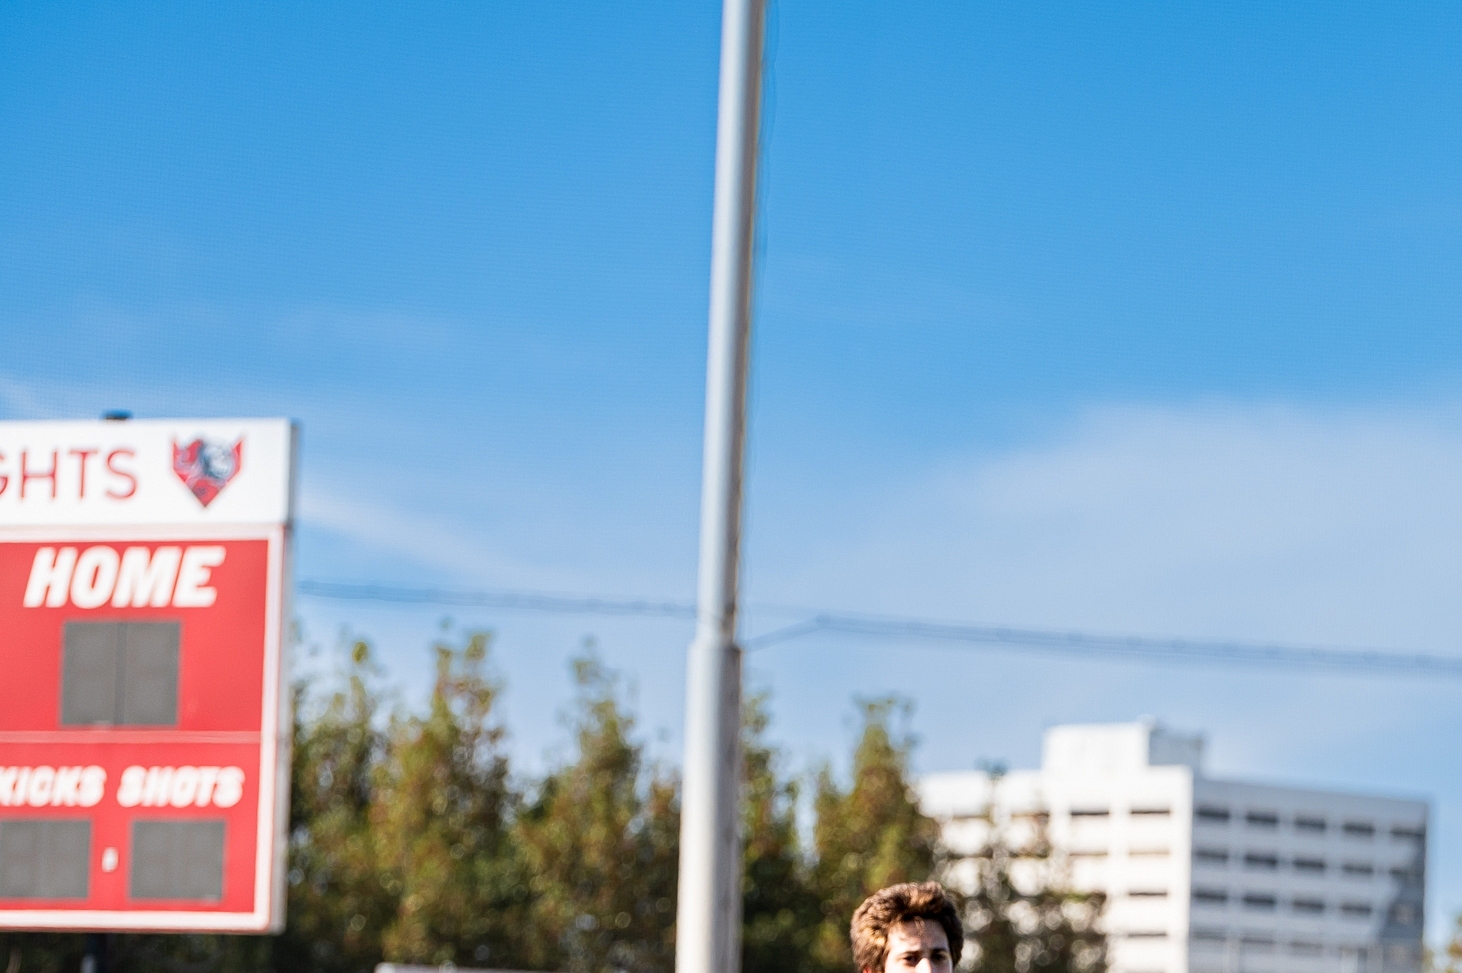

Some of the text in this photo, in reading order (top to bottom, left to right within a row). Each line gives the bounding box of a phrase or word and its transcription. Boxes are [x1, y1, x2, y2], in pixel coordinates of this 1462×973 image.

[0, 447, 139, 500] HTS
[22, 545, 227, 610] HOME
[117, 765, 246, 808] SHOTS
